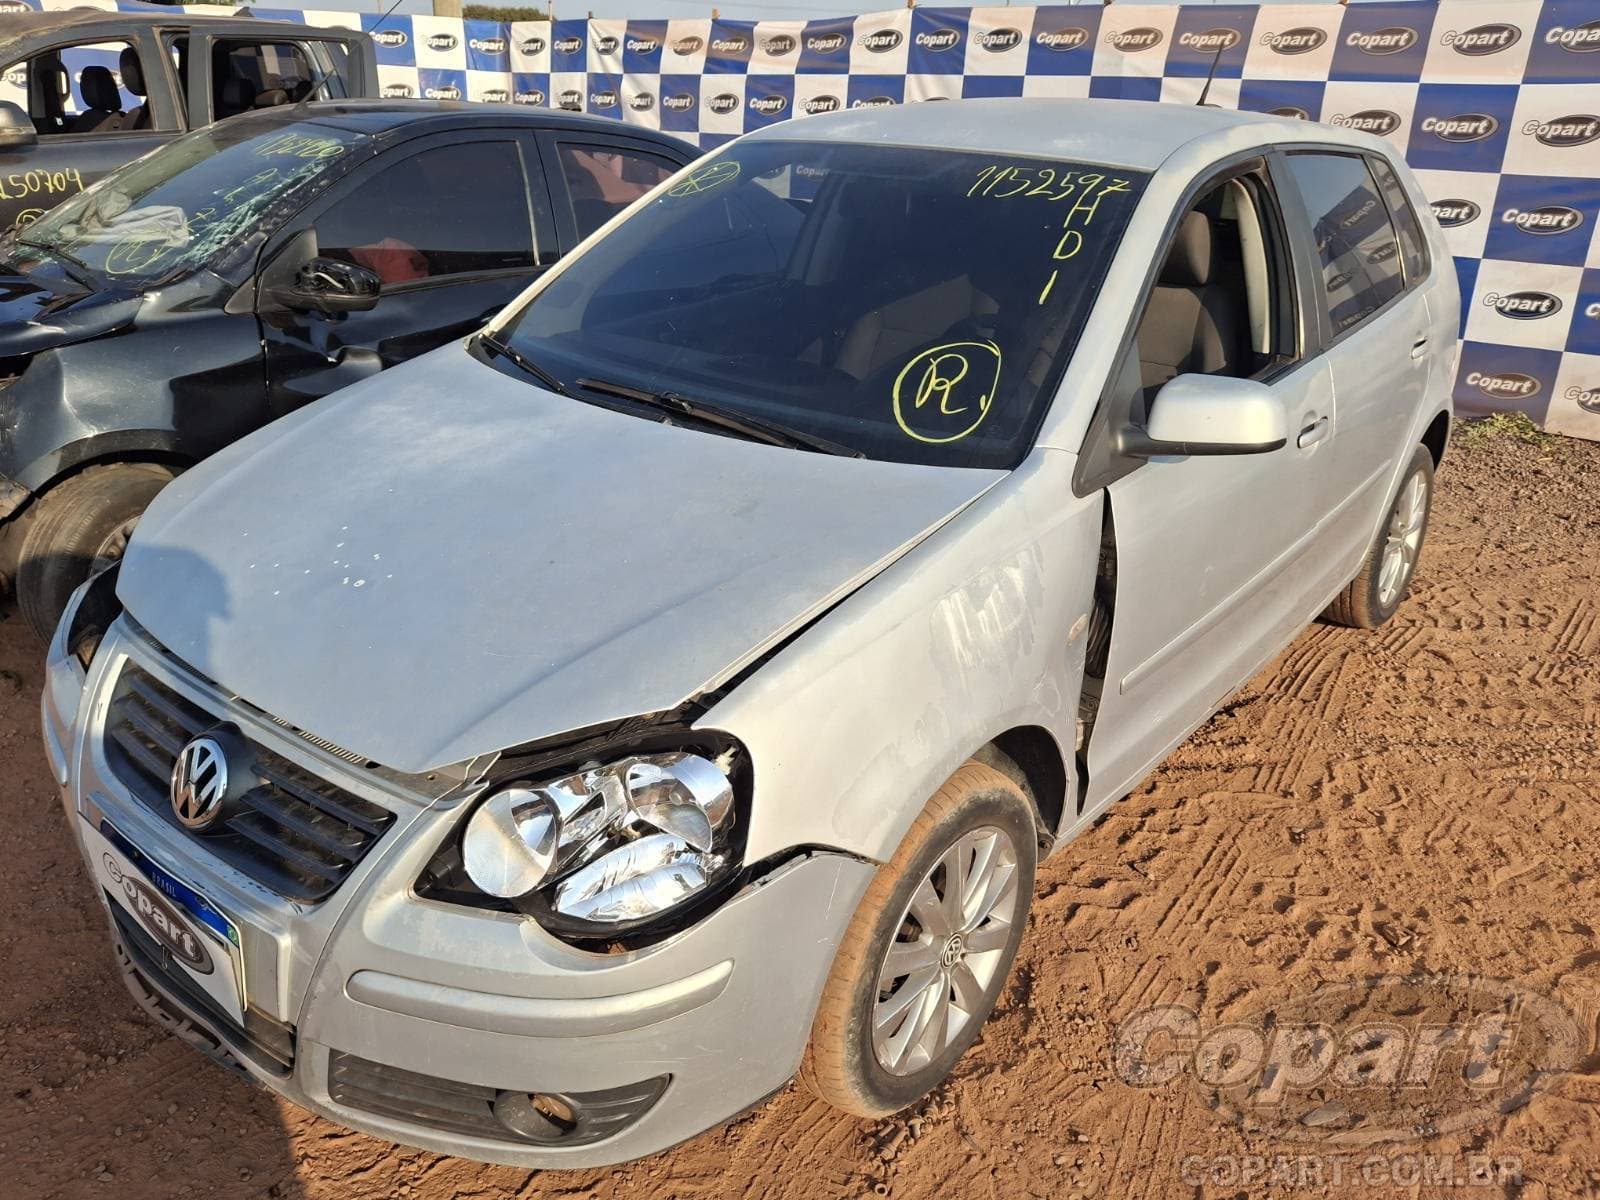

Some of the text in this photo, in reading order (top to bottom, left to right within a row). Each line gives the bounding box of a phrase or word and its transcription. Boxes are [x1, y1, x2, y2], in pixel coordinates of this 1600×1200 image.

[807, 37, 843, 50] Copart
[857, 33, 896, 48] Copart
[915, 31, 955, 46] Copart
[974, 31, 1016, 46] Copart
[1036, 31, 1083, 46] Copart
[1104, 31, 1153, 46] Copart
[1179, 32, 1233, 46] Copart
[1260, 30, 1319, 48] Copart
[1346, 31, 1409, 48] Copart
[1440, 29, 1510, 49] Copart
[1546, 26, 1600, 46] Copa
[469, 39, 504, 51] Copart
[554, 40, 579, 51] Copart
[627, 39, 656, 51] Copart
[668, 40, 699, 51] Copart
[711, 39, 745, 52] Copart
[759, 39, 791, 51] Copart
[381, 88, 409, 98] opart
[425, 88, 457, 100] Copart
[515, 92, 541, 104] Copart
[590, 94, 616, 105] Copart
[663, 96, 692, 109] Copart
[705, 96, 734, 108] Copart
[749, 98, 785, 110] Copart
[798, 97, 836, 111] Copart
[1329, 112, 1391, 131] Copart
[1421, 116, 1487, 135] Copart
[1521, 119, 1594, 138] Copart
[966, 165, 1132, 202] 1152597
[1431, 204, 1470, 222] part
[1501, 207, 1573, 229] Copart
[1482, 292, 1552, 313] Copart
[1465, 372, 1535, 393] Copart
[1564, 385, 1600, 405] Cop
[151, 871, 177, 898] BRASIL
[103, 852, 198, 960] Copart
